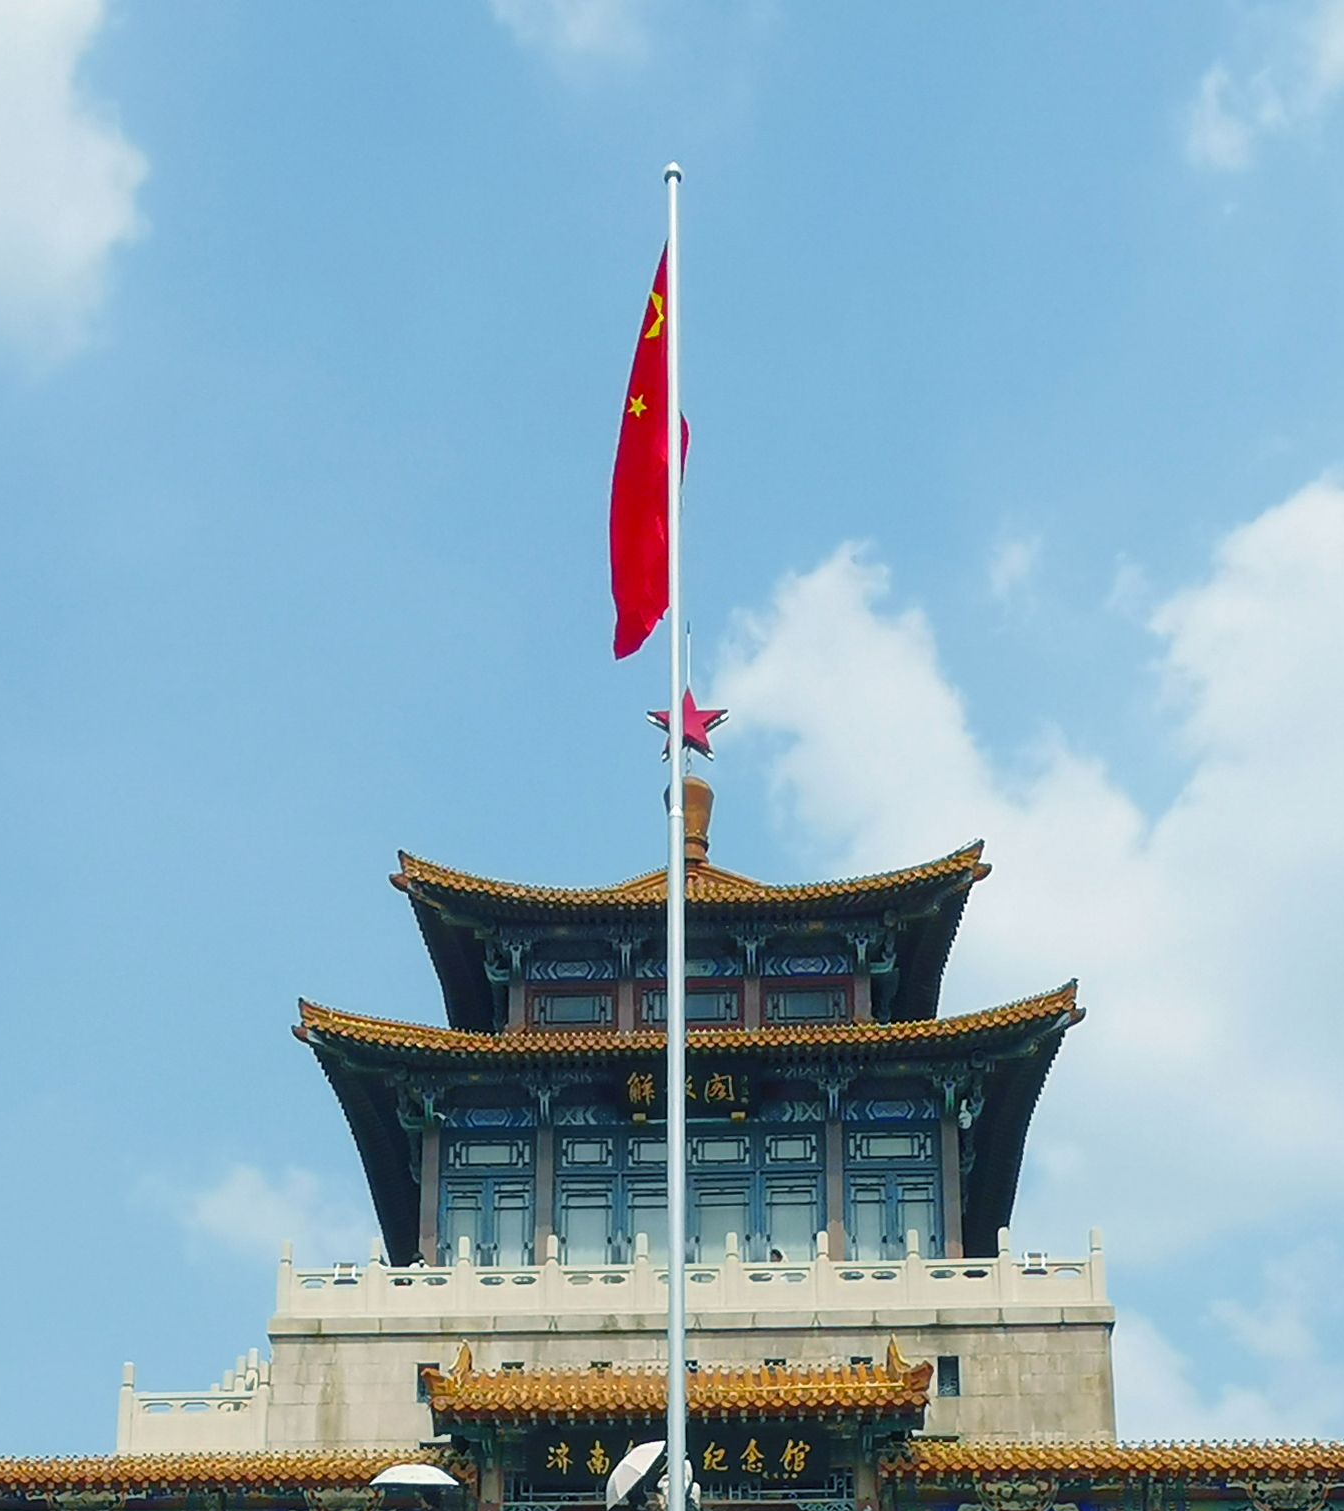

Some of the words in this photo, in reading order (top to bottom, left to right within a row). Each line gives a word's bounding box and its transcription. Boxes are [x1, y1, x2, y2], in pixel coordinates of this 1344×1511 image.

[546, 1438, 813, 1476] 济南纪念馆
